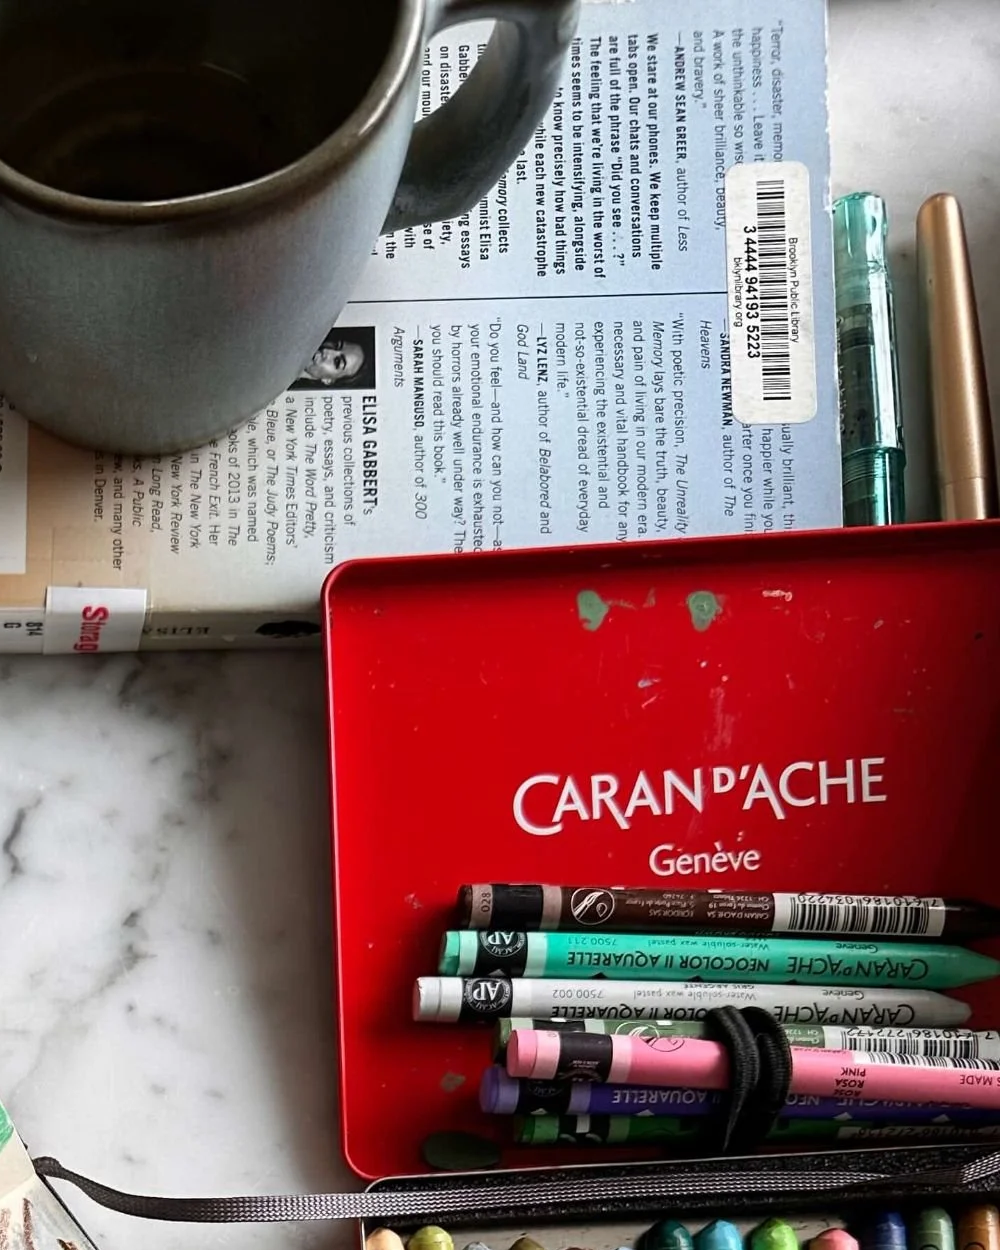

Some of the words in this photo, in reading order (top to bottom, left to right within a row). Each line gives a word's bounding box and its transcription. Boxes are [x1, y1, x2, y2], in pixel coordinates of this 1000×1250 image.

[590, 36, 603, 57] The
[628, 34, 640, 59] tabs
[647, 33, 659, 51] We
[588, 60, 603, 99] feeling
[647, 54, 659, 84] stare
[629, 96, 641, 116] Our
[648, 87, 659, 99] at
[591, 102, 604, 125] that
[648, 101, 658, 120] our
[675, 94, 687, 122] SEAN
[629, 119, 642, 150] chats
[630, 153, 643, 174] and
[589, 162, 606, 194] living
[649, 171, 662, 189] We
[676, 167, 690, 206] author
[593, 196, 606, 207] in
[647, 193, 663, 221] keep
[677, 208, 691, 221] of
[593, 210, 606, 228] the
[630, 178, 645, 258] conversations
[743, 225, 757, 234] 3
[593, 231, 606, 264] worst
[648, 224, 664, 270] multiple
[678, 225, 691, 252] Less
[744, 237, 758, 273] 4444
[787, 237, 798, 278] Brooklyn
[594, 266, 607, 278] of
[745, 276, 759, 320] 94193
[789, 280, 799, 310] Public
[789, 311, 800, 343] Library
[650, 320, 666, 368] Memory
[698, 319, 713, 369] Heavens
[746, 325, 760, 359] 5223
[391, 325, 407, 387] Arguments
[574, 322, 590, 422] not-so-existential
[651, 370, 667, 394] lays
[340, 395, 355, 444] previous
[362, 395, 378, 435] ELISA
[654, 397, 668, 423] bare
[577, 425, 591, 459] dread
[655, 426, 669, 446] the
[247, 437, 260, 471] which
[414, 435, 426, 473] author
[343, 446, 356, 511] collections
[415, 476, 427, 488] of
[578, 463, 592, 475] of
[247, 475, 257, 498] was
[324, 485, 337, 507] and
[415, 492, 428, 519] 300
[576, 479, 592, 533] everyday
[247, 501, 260, 542] named
[344, 513, 357, 526] of
[324, 511, 338, 566] criticism
[25, 622, 43, 636] 814
[73, 606, 109, 652] Storag
[512, 767, 705, 836] CARAN
[648, 841, 761, 877] Genève
[567, 950, 661, 968] AQUARELLE
[679, 955, 770, 973] NEOCOLOR
[855, 958, 929, 981] CARAN
[551, 989, 604, 999] 7500.002
[551, 1004, 645, 1020] AQUARELLE
[841, 1003, 915, 1026] CARAN
[834, 1078, 865, 1088] ROSA
[840, 1066, 867, 1077] PINK
[959, 1074, 994, 1086] MADE
[611, 1089, 707, 1104] AQUARELLE
